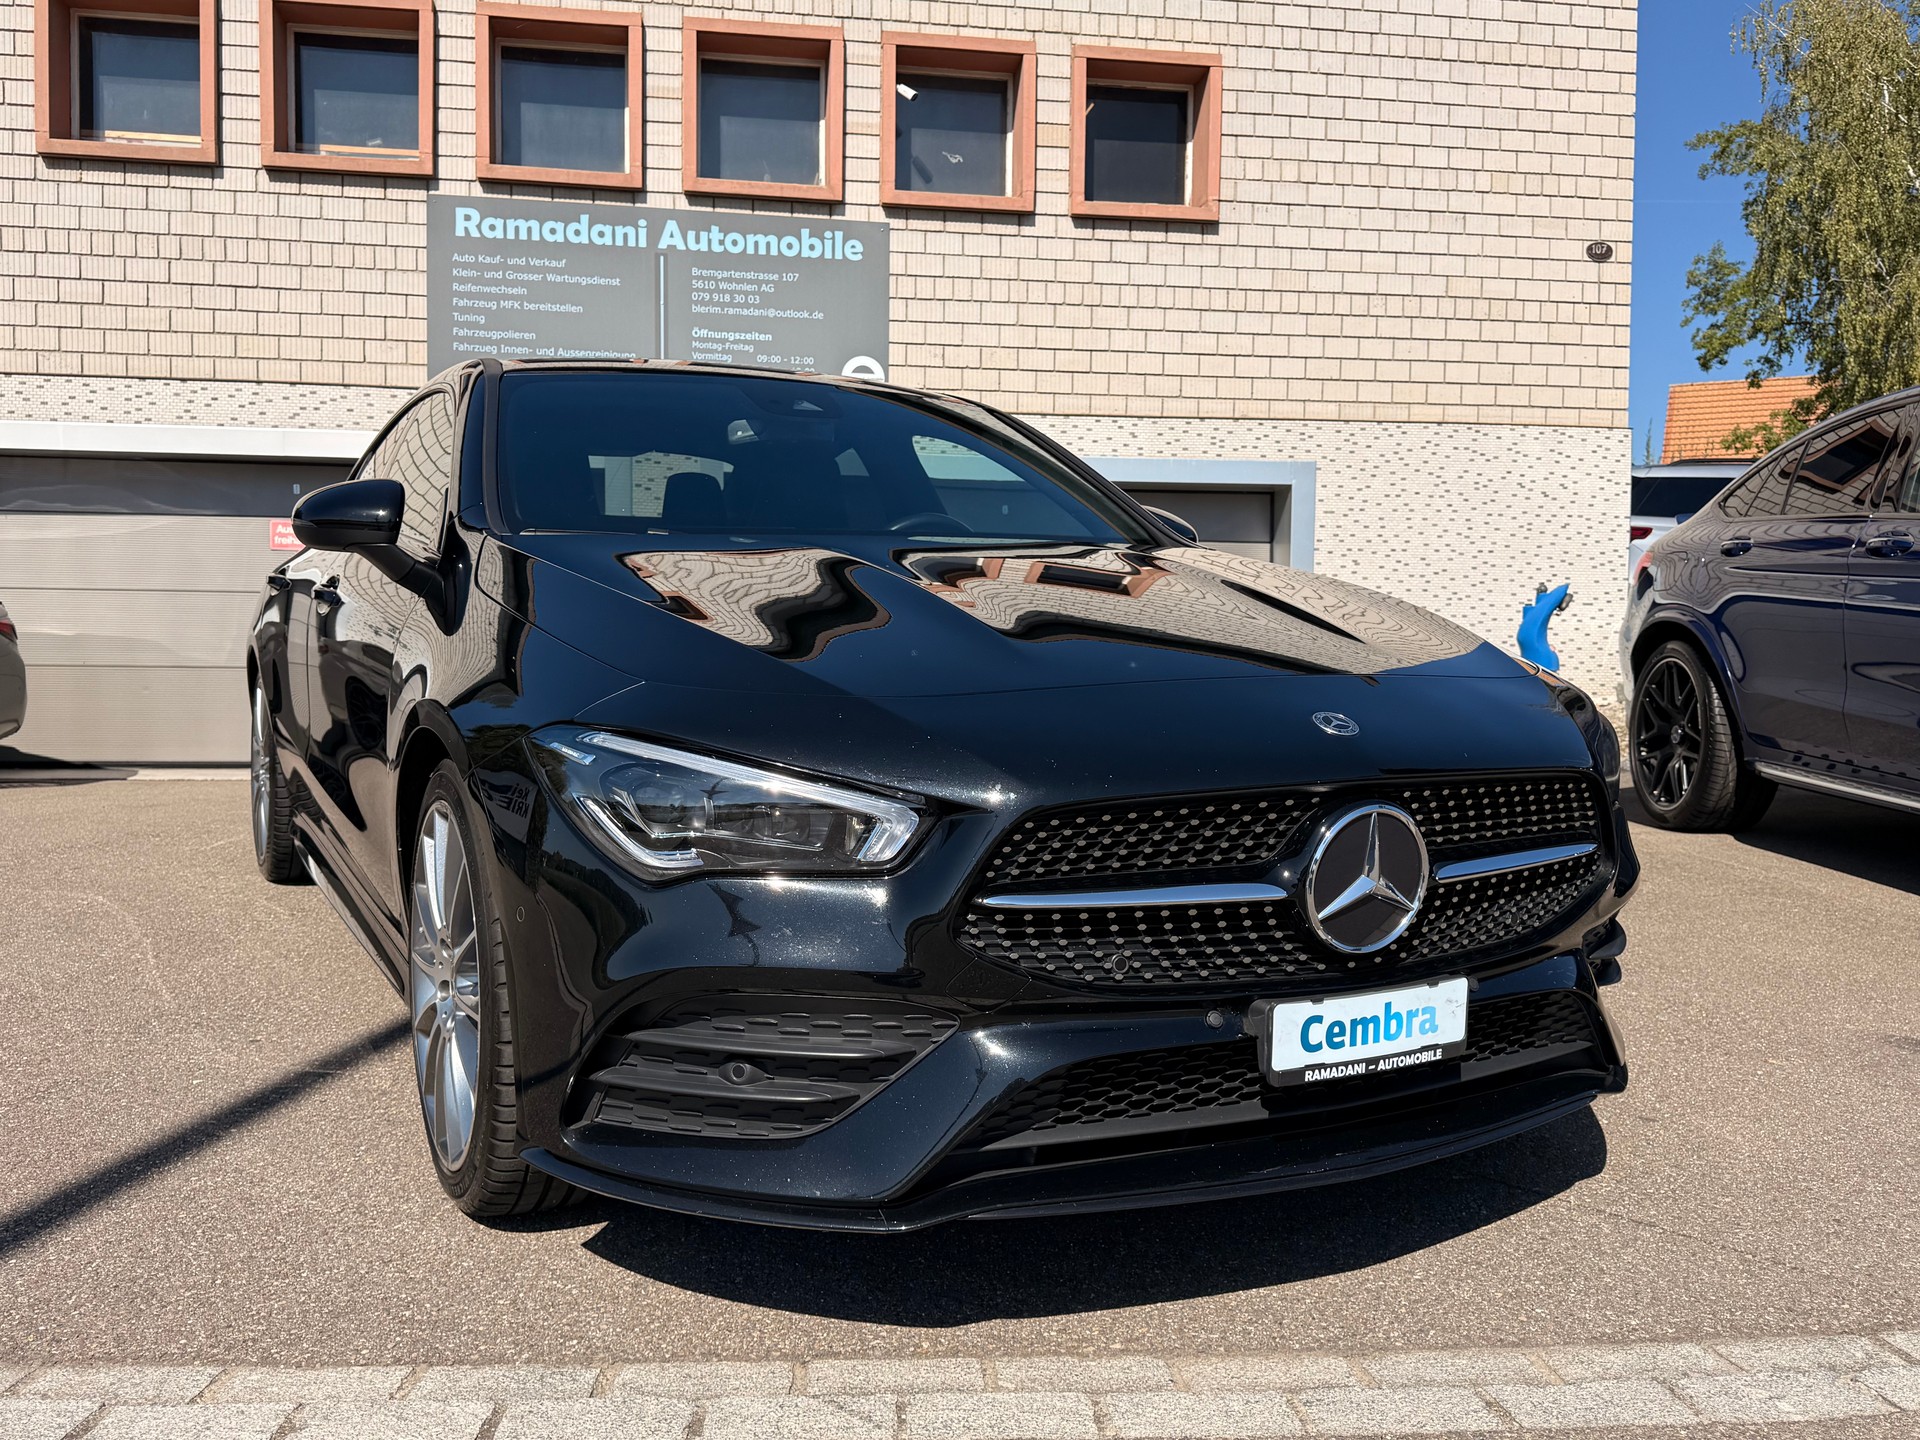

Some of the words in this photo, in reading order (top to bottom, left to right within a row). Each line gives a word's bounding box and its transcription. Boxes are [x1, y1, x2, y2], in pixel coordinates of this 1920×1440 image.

[454, 207, 648, 248] Ramadani
[657, 219, 864, 261] Automobile
[1592, 244, 1607, 254] 107
[452, 253, 475, 262] Auto
[478, 254, 504, 264] Kauf-
[507, 256, 526, 265] und
[528, 257, 566, 268] Verkauf
[452, 268, 481, 278] Klein-
[484, 270, 502, 279] und
[505, 271, 544, 281] Grosser
[546, 273, 621, 287] Wartungsdienst
[691, 267, 779, 281] Bremgartenstrasse
[782, 272, 799, 281] 107
[452, 283, 527, 295] Reifenwechseln
[691, 280, 715, 289] 5610
[760, 284, 774, 293] AG
[691, 292, 710, 301] 079
[712, 293, 730, 302] 918
[733, 294, 745, 303] 30
[747, 295, 760, 304] 03
[452, 298, 497, 310] Fahrzeug
[500, 300, 521, 310] MFK
[524, 301, 583, 313] bereitstellen
[691, 304, 824, 320] blerim.ramadani@outlook.de
[452, 312, 485, 324] Tuning
[452, 327, 536, 340] Fahrzeugpolieren
[691, 327, 773, 342] Öffnungszeiten
[452, 342, 497, 354] Fahrzueg
[501, 344, 533, 354] Innen-
[536, 346, 554, 356] und
[691, 341, 754, 352] Montag-Freitag
[691, 351, 732, 362] Vormittag
[756, 355, 781, 363] 09:00
[790, 356, 815, 365] 12:00
[1300, 1001, 1439, 1053] Cembra
[1304, 1062, 1366, 1082] RAMADANI
[1378, 1048, 1442, 1071] AUTOMOBILE
